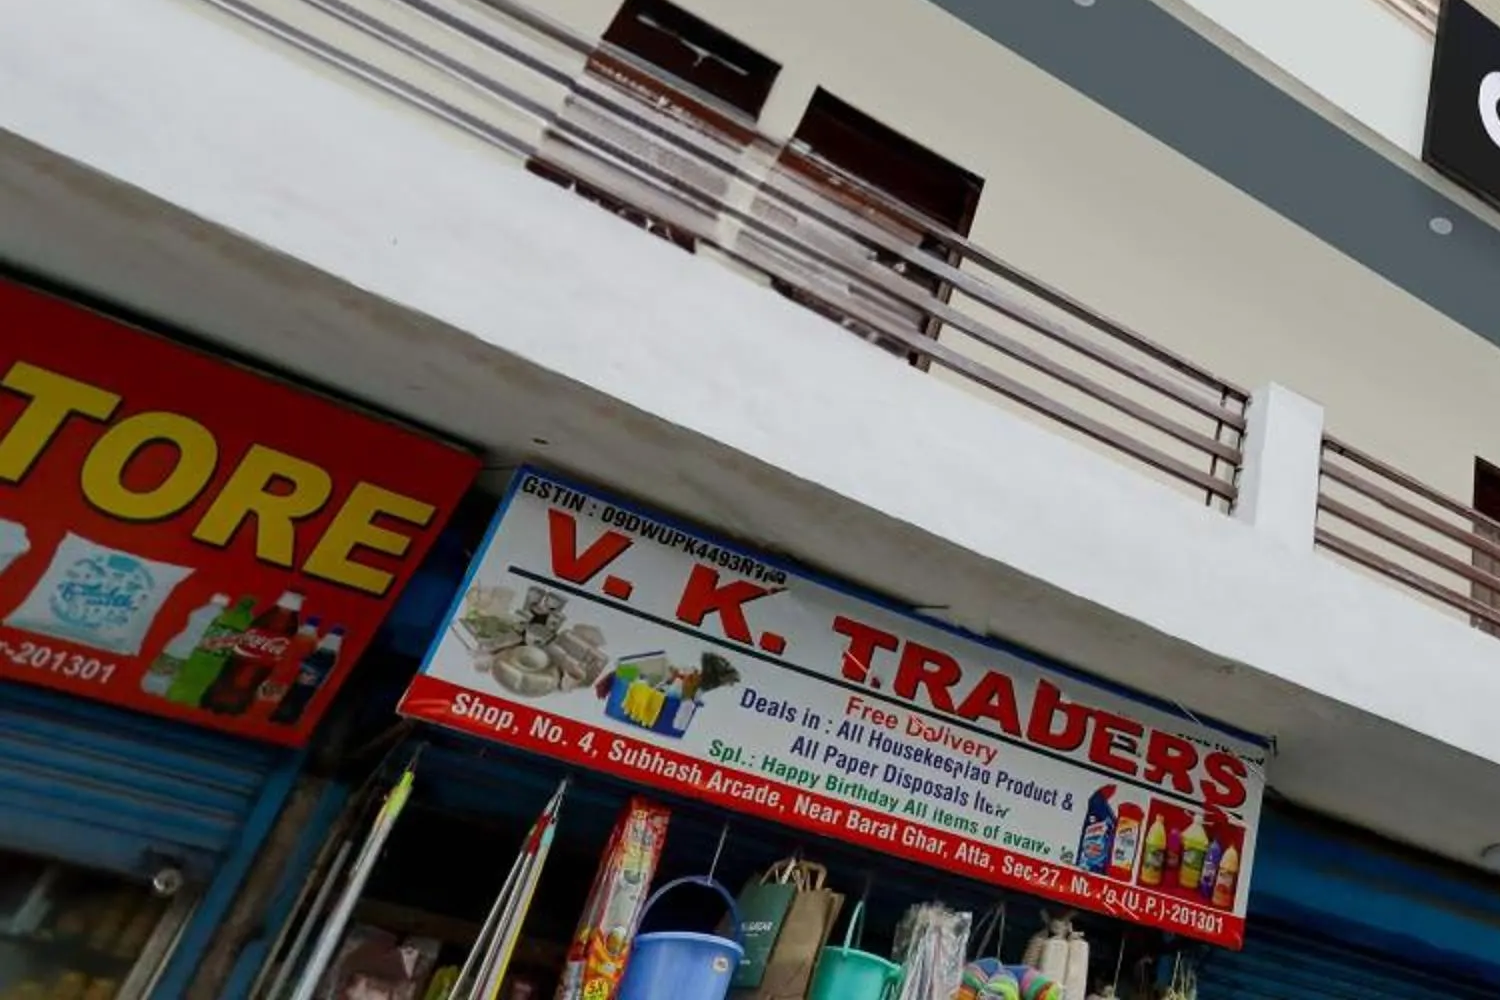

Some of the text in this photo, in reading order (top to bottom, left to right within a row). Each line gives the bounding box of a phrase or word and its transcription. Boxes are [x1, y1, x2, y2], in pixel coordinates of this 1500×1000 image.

[522, 475, 587, 517] GSTIN
[547, 508, 634, 600] V.
[675, 563, 786, 655] K.
[832, 615, 1247, 810] TRADERS
[739, 687, 797, 724] Deals
[802, 704, 822, 731] in
[836, 720, 864, 748] All
[996, 770, 1059, 808] Product
[1061, 793, 1074, 811] &
[845, 696, 899, 730] Free
[451, 693, 519, 735] Shop,
[529, 715, 568, 747] No.
[577, 731, 598, 757] 4,
[607, 739, 701, 785] Subhash
[706, 771, 786, 812] Arcade,
[792, 793, 841, 825] Near
[846, 808, 899, 842] Barat
[901, 829, 949, 859] Ghar,
[954, 842, 995, 873] Atta,
[1001, 854, 1064, 894] Sec-27,
[762, 754, 821, 789] Happy
[826, 773, 899, 812] Birthday
[903, 798, 928, 822] All
[983, 821, 1001, 841] of
[790, 736, 820, 765] All
[823, 745, 878, 781] Paper
[883, 764, 969, 810] Disposals
